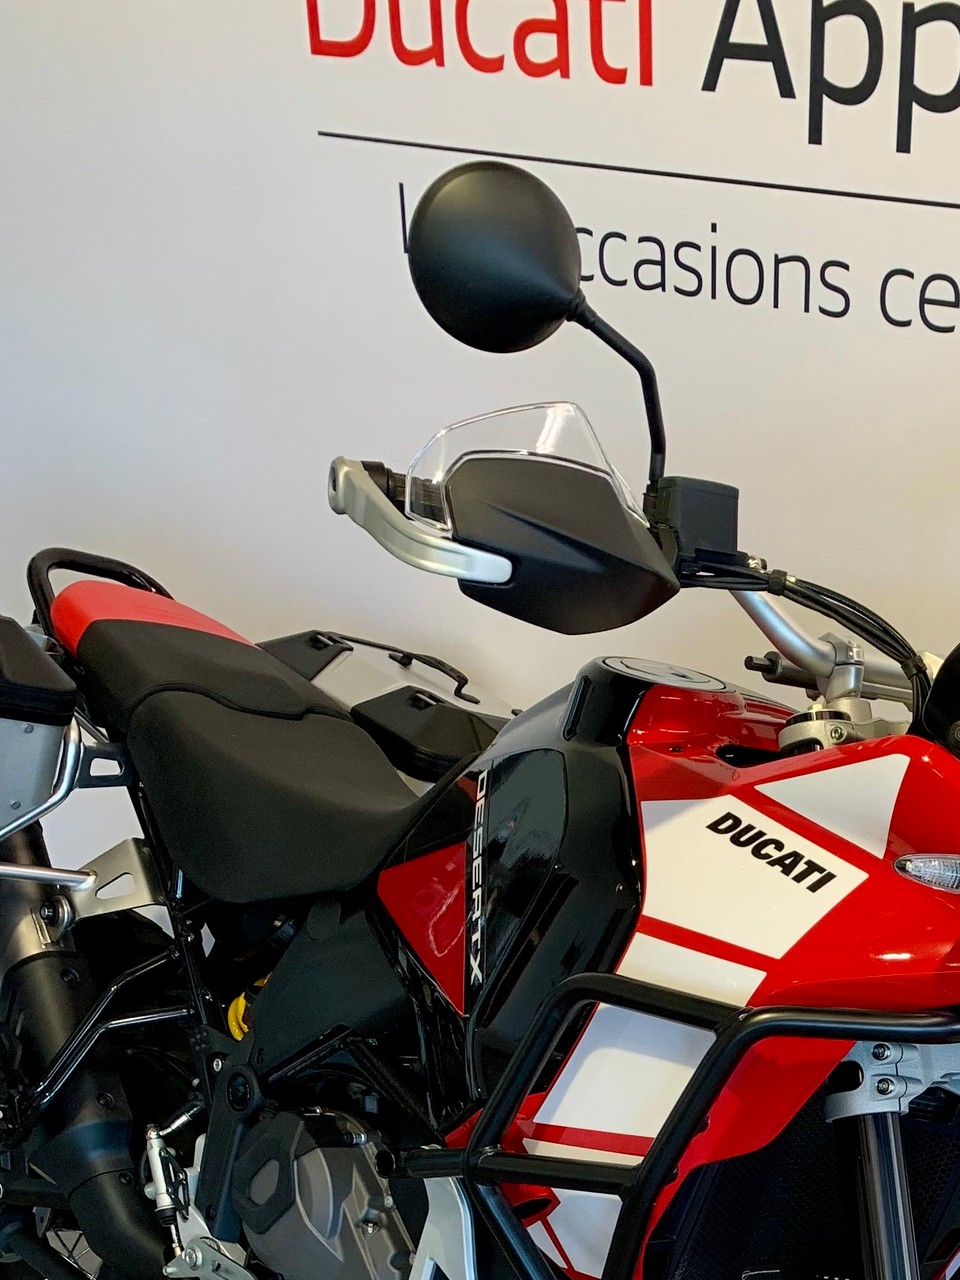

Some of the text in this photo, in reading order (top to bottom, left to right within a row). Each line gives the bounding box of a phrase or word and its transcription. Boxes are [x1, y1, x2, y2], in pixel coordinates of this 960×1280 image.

[575, 222, 851, 318] ccasions
[470, 769, 488, 986] DESERTX
[705, 811, 837, 894] DUCATI
